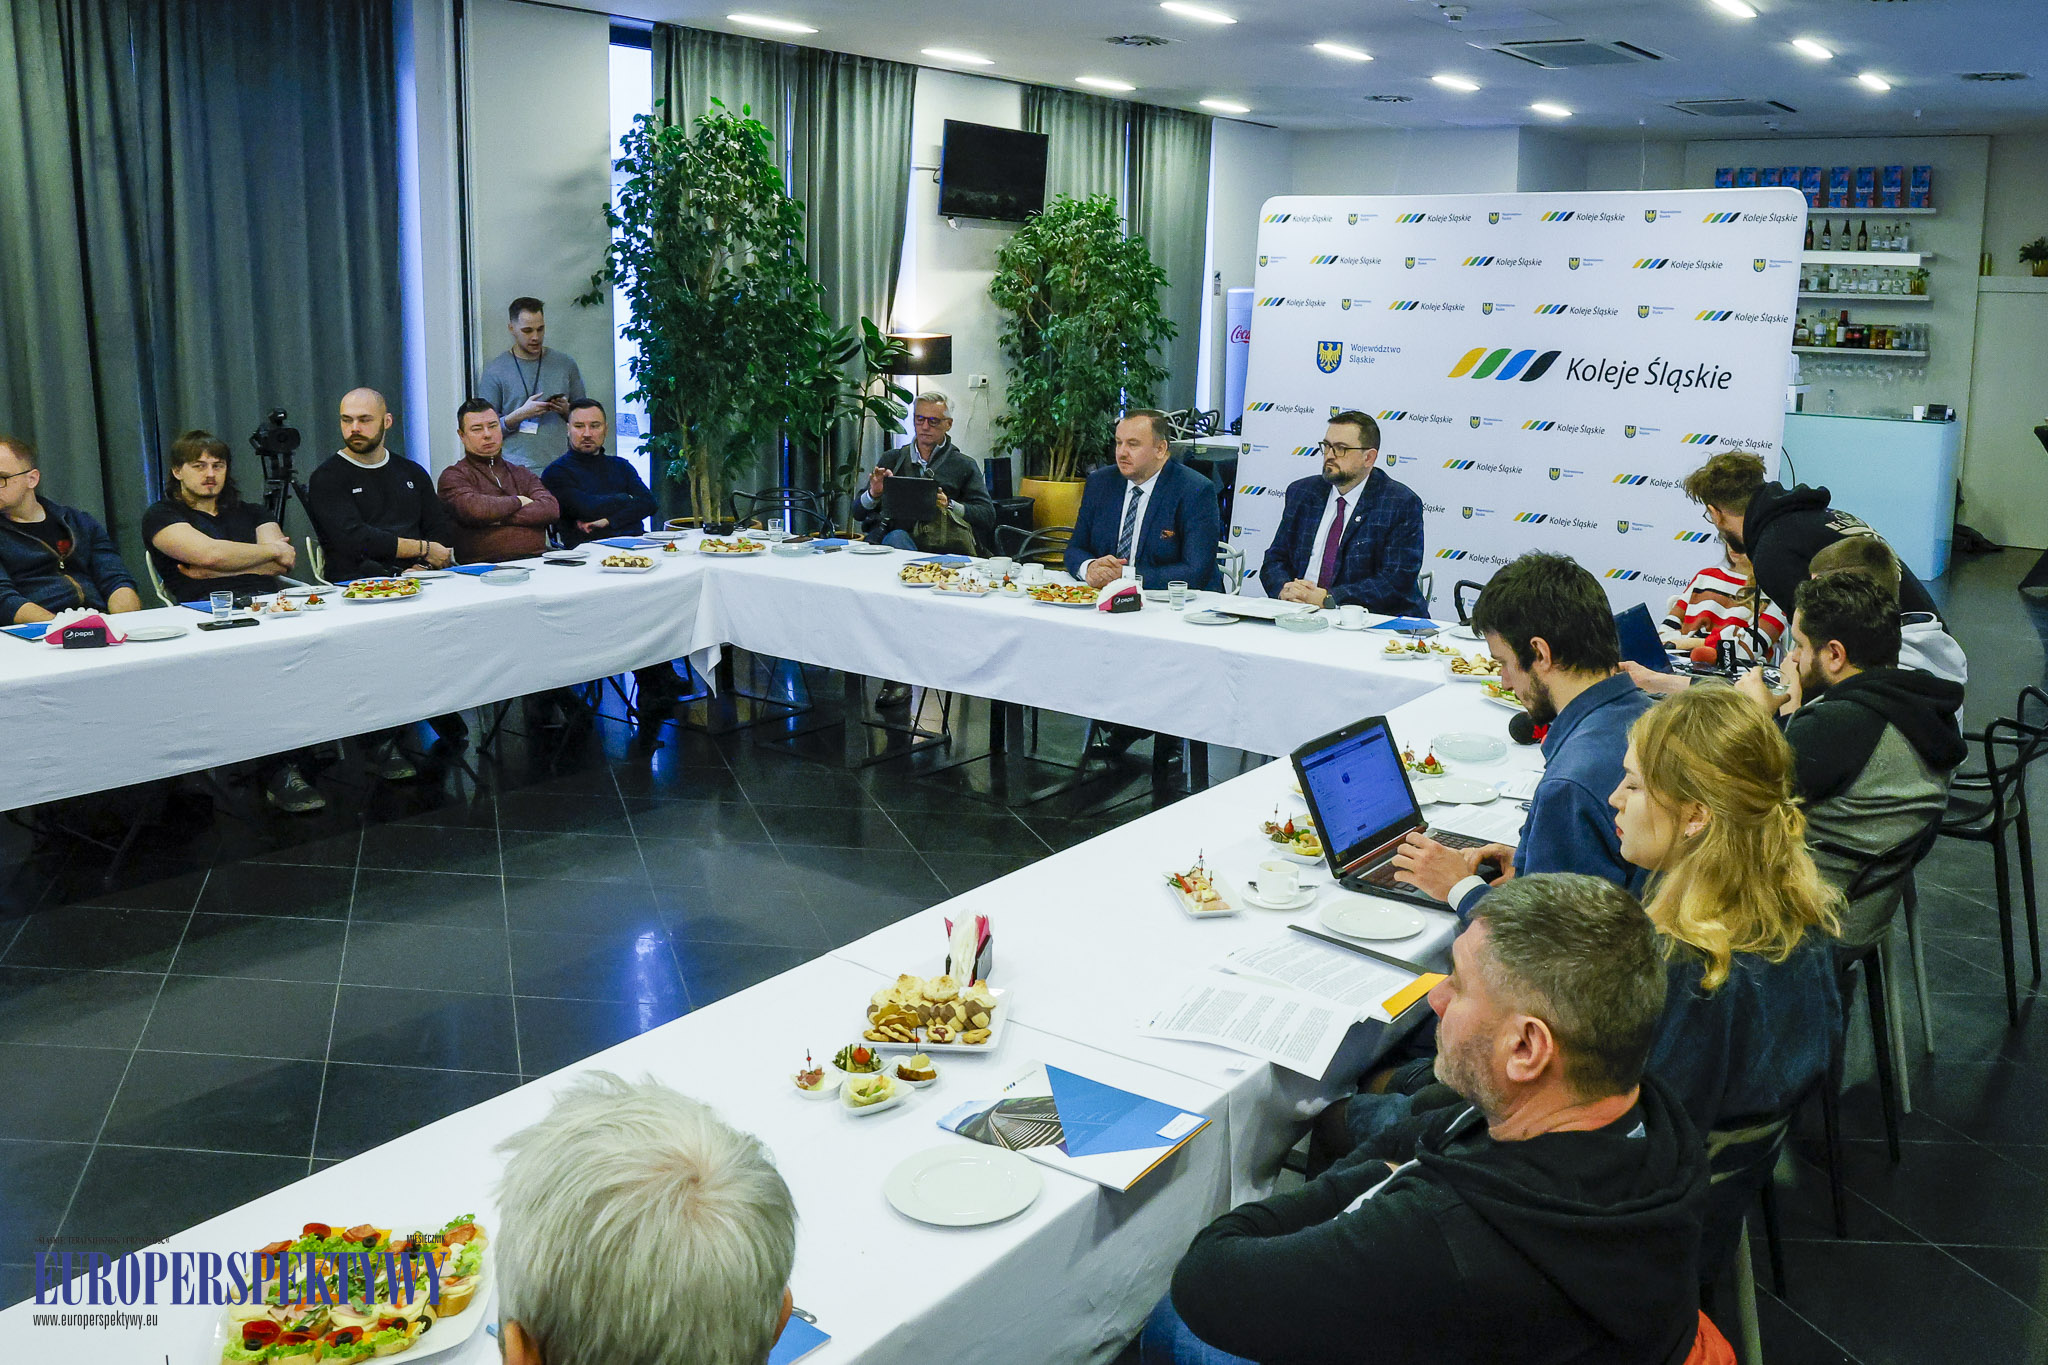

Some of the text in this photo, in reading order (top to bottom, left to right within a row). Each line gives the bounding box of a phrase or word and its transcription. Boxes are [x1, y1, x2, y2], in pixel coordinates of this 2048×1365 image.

[1292, 215, 1310, 224] Koleje
[1427, 214, 1446, 224] Koleje
[1576, 213, 1598, 222] Koleje
[1743, 214, 1768, 224] Koleje
[1340, 257, 1359, 265] Koleje
[1496, 258, 1516, 267] Koleje
[1671, 261, 1694, 270] Koleje
[1286, 299, 1304, 308] Koleje
[1421, 303, 1441, 312] Koleje
[1569, 307, 1592, 316] Koleje
[1735, 313, 1759, 323] Koleje
[1351, 343, 1401, 354] Województwo
[1566, 357, 1732, 393] Koleje Śląskie
[1275, 405, 1293, 414] Koleje
[1409, 414, 1428, 423] Koleje
[1557, 424, 1579, 434] Koleje
[1719, 437, 1743, 449] Koleje
[1476, 463, 1497, 473] Koleje
[1650, 478, 1673, 489] Koleje
[1549, 517, 1571, 527] Koleje
[1469, 553, 1489, 564] Koleje
[1642, 573, 1691, 587] Koleje Śląski
